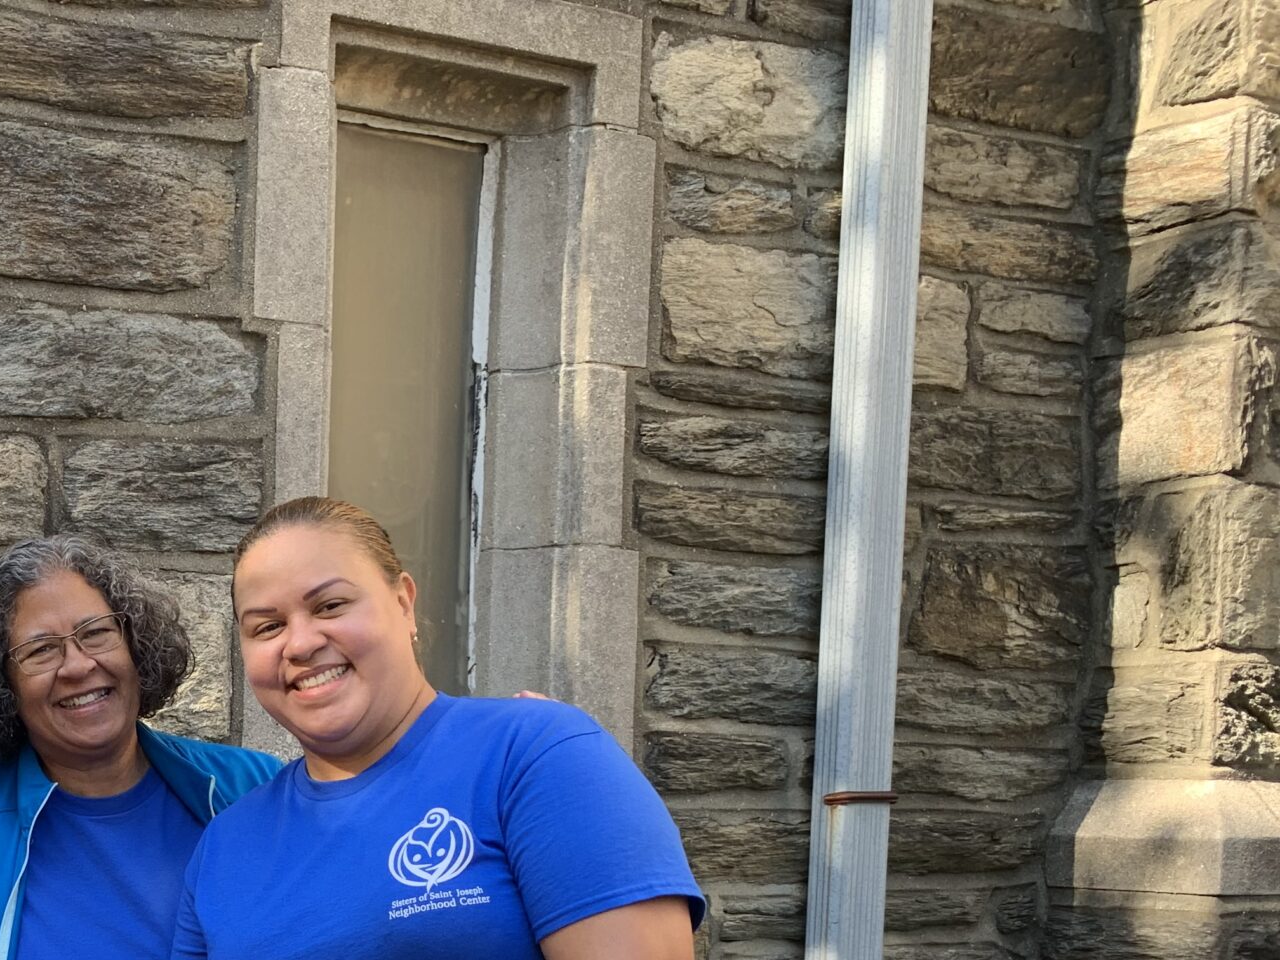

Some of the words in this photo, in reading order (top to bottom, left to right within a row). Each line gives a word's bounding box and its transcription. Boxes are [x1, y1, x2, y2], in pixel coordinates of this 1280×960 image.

[389, 898, 456, 920] Neighborhood
[460, 896, 490, 905] Center
[392, 897, 416, 908] Sisters
[419, 893, 427, 901] of
[430, 890, 452, 900] Saint
[456, 886, 483, 897] Joseph
